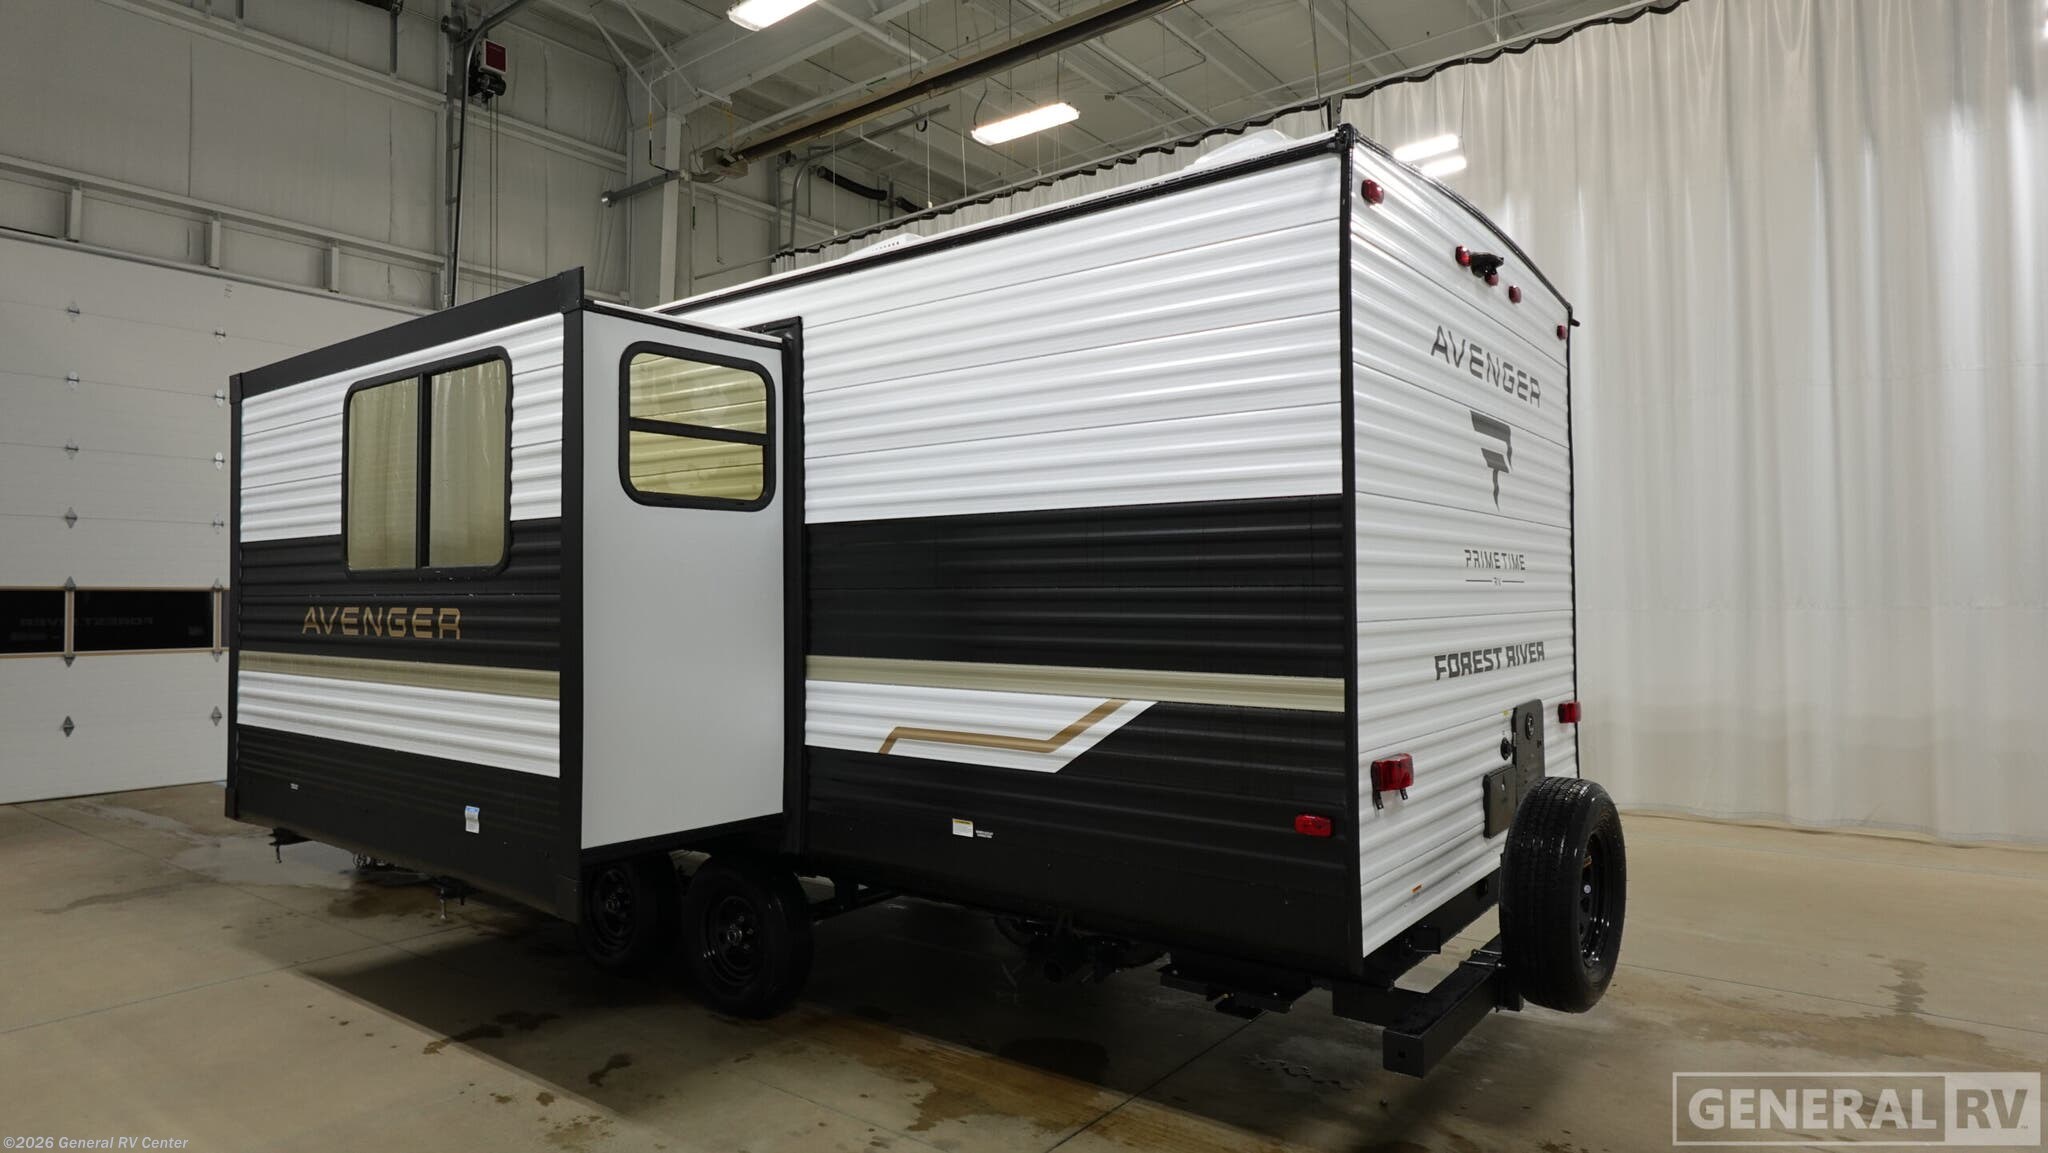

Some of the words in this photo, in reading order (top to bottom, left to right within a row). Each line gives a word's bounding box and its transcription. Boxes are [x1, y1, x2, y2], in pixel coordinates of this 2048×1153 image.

[1431, 325, 1541, 408] AVENGER
[301, 606, 461, 640] AVENGER
[1434, 647, 1503, 681] FOREST
[1505, 641, 1546, 668] RIVER
